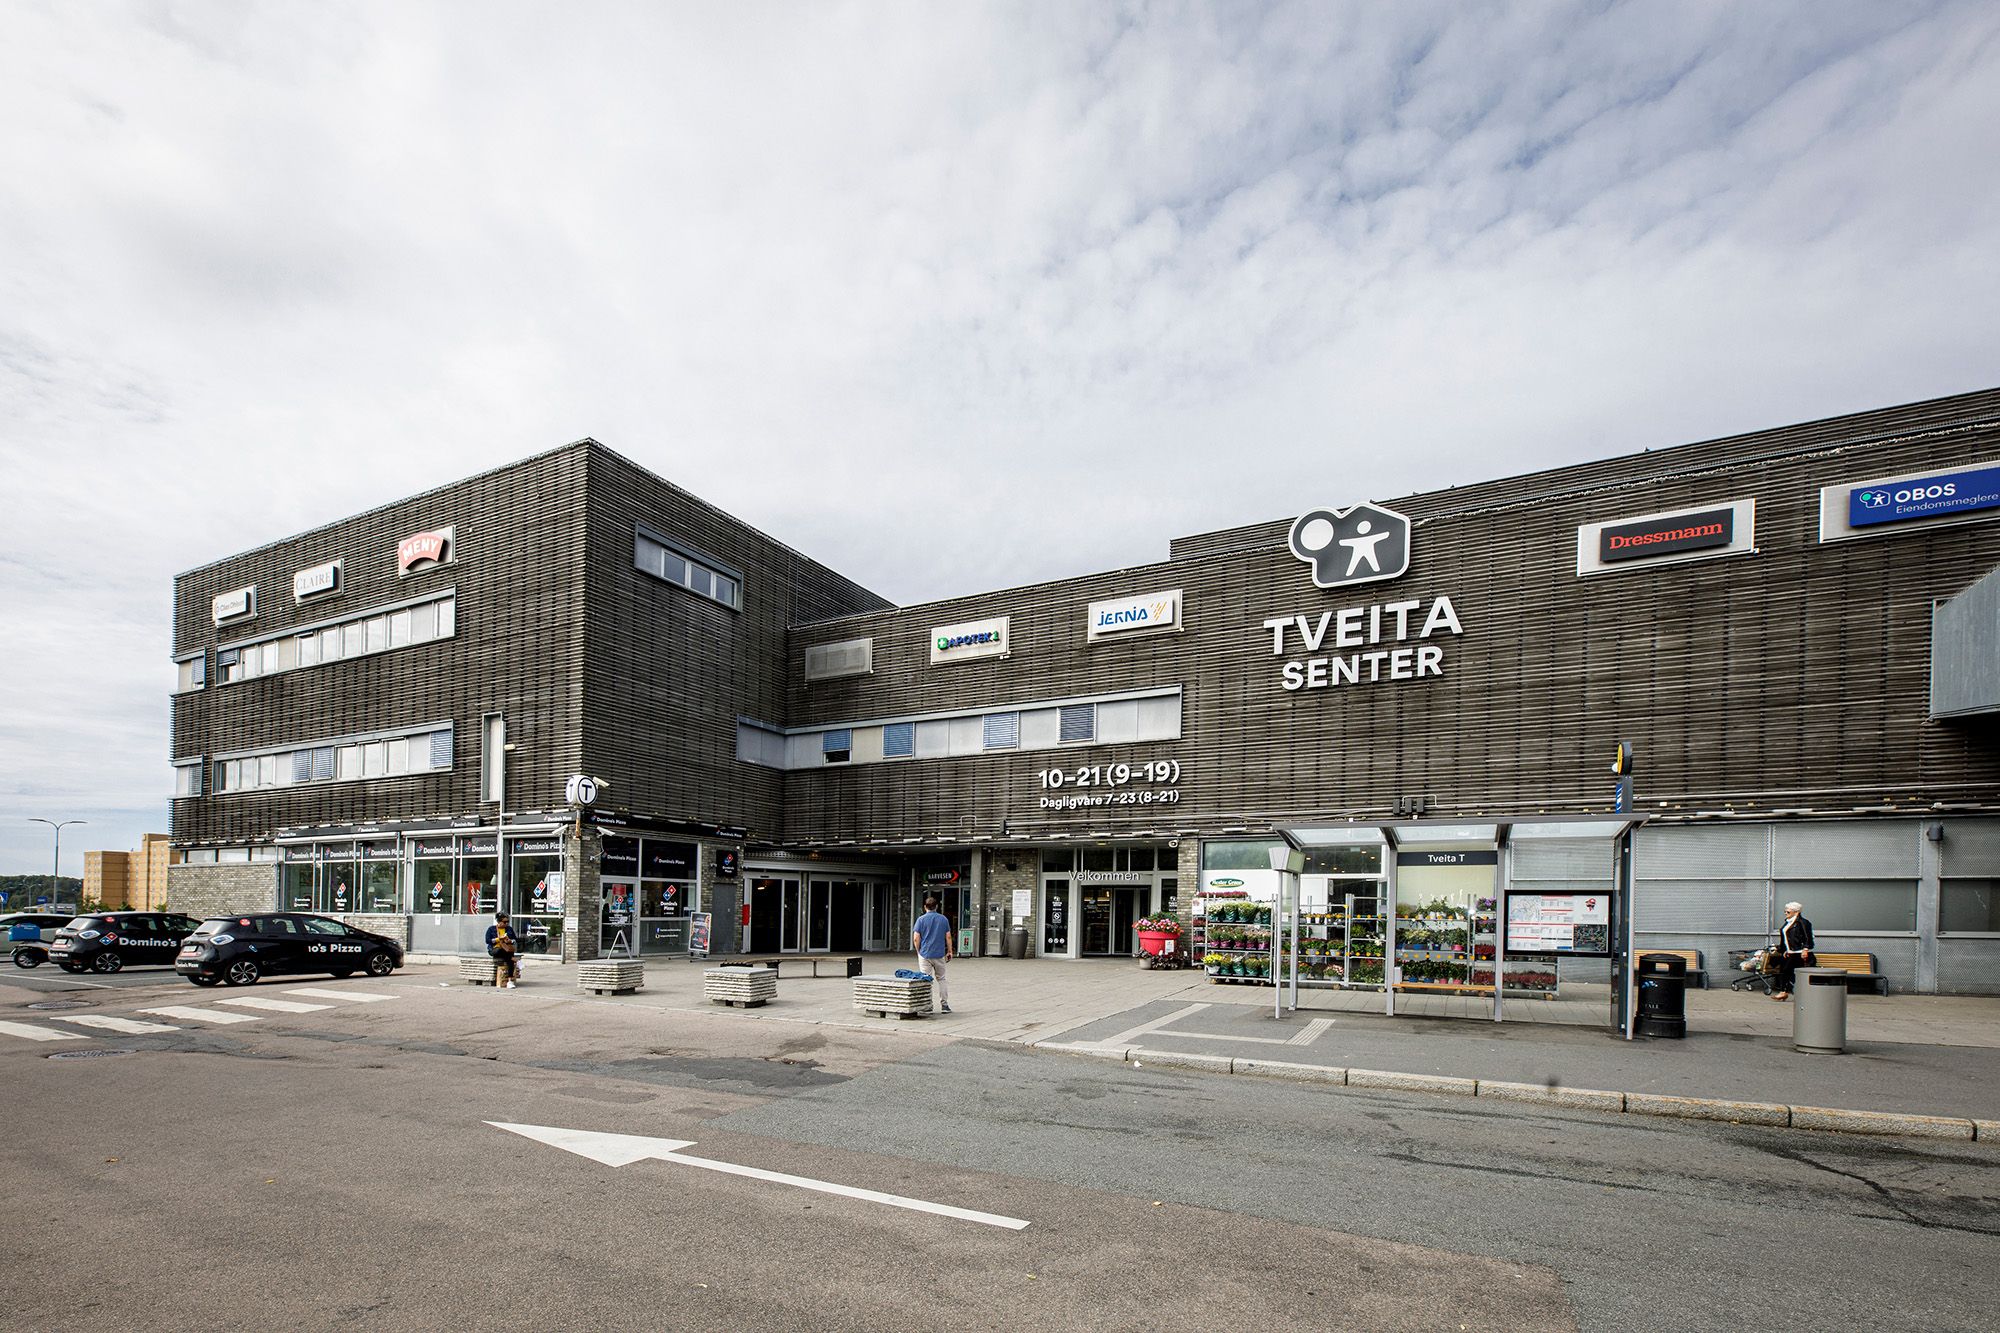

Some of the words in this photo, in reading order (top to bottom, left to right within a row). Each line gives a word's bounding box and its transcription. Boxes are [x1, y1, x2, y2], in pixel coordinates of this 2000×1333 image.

[1895, 483, 1956, 503] OBOS
[1896, 493, 1999, 514] Eiendomsmeglere
[1609, 523, 1723, 549] Dressmann
[402, 538, 438, 560] MENY
[295, 572, 332, 591] CLAIRE
[1263, 596, 1464, 655] TVEITA
[1281, 646, 1443, 690] SENTER
[581, 783, 592, 801] T
[1040, 795, 1103, 810] Dagligvare
[523, 842, 549, 850] Domino's
[1427, 854, 1457, 862] Tveita
[1458, 853, 1466, 862] T
[1068, 869, 1140, 881] Velkommen
[118, 937, 178, 948] Domino's
[329, 942, 362, 953] Pizza
